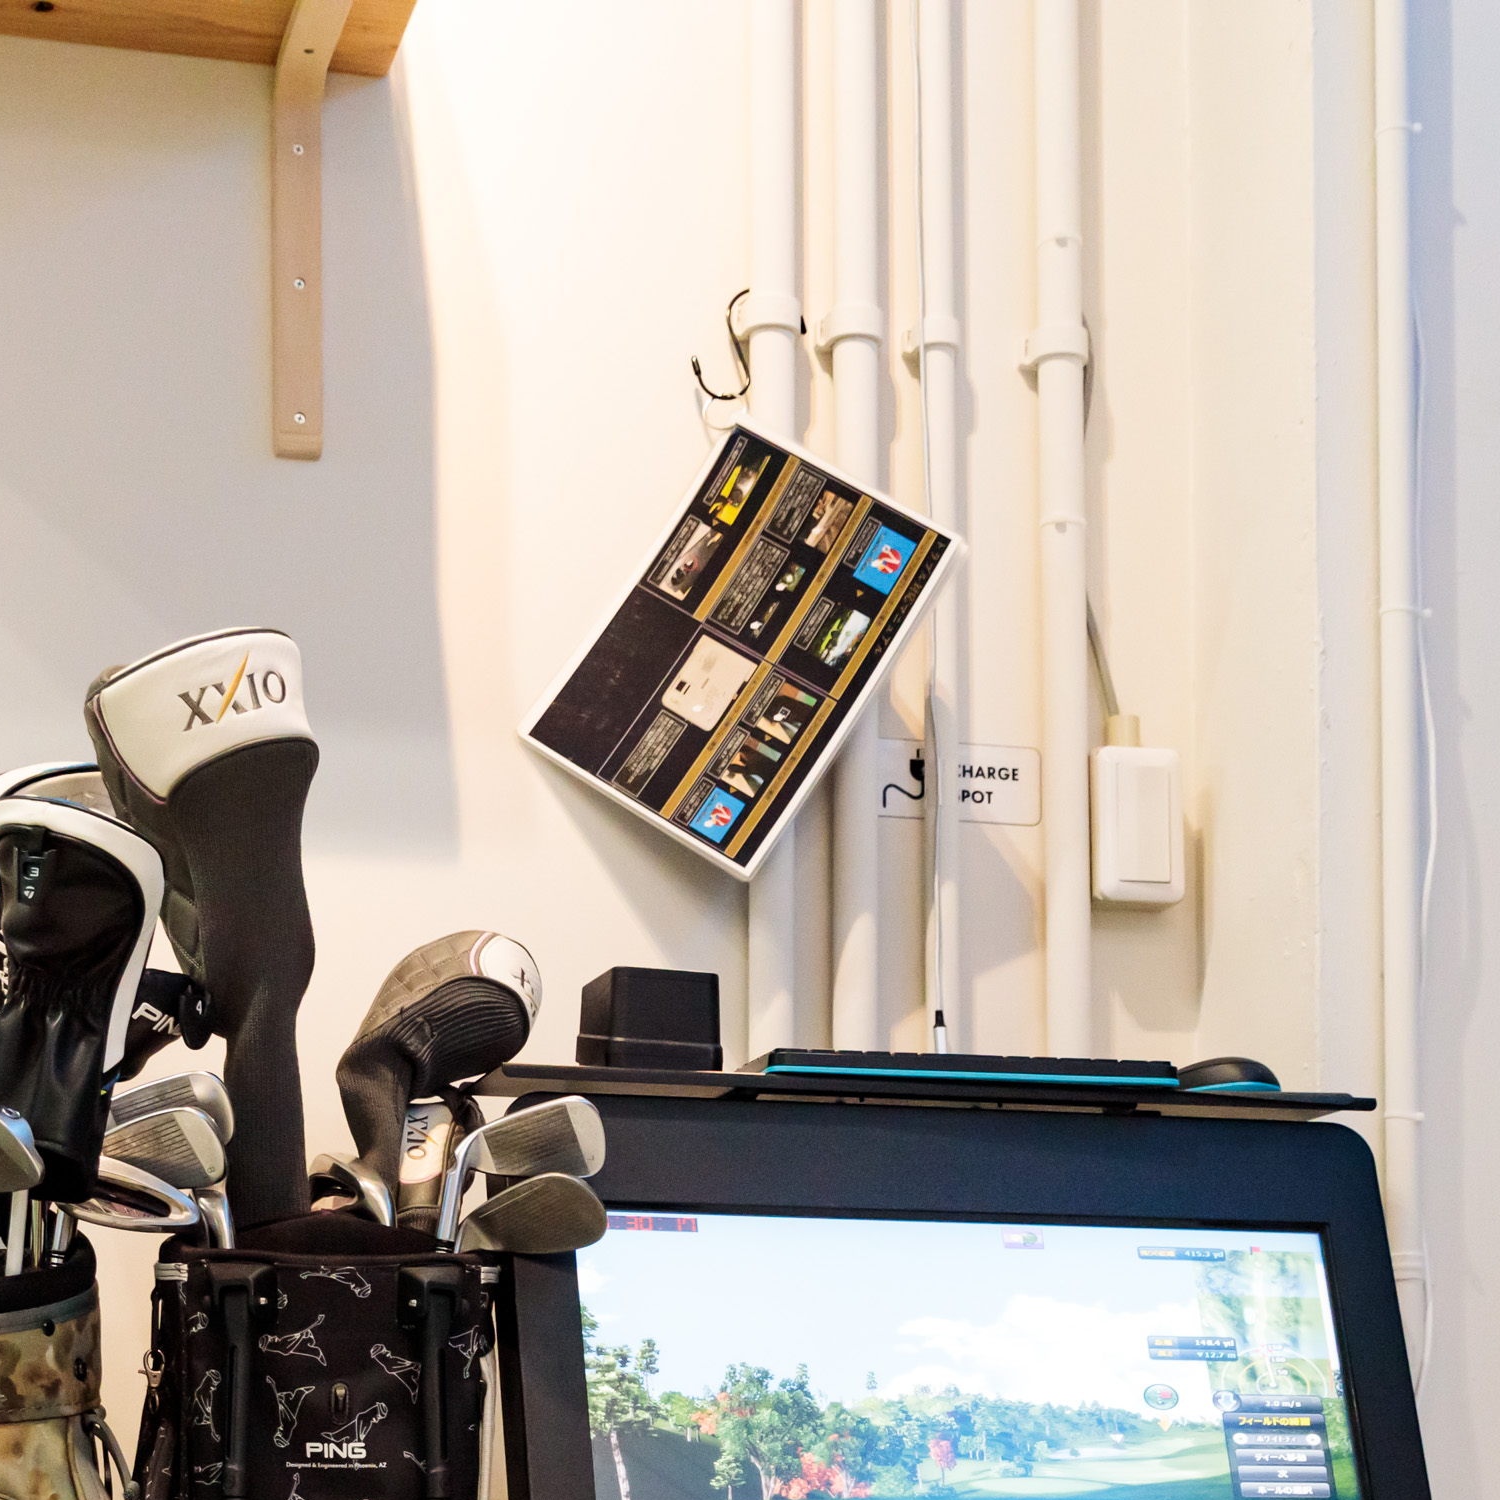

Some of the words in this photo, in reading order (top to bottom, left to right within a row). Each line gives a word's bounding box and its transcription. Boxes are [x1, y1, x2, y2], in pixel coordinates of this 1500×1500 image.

[177, 650, 287, 732] XXIO
[958, 764, 1020, 782] HARGE
[958, 789, 993, 805] POT
[195, 1000, 203, 1015] 4
[406, 1114, 439, 1160] XXIO
[1184, 1250, 1210, 1258] 415.3
[1212, 1250, 1224, 1259] yd
[1222, 1340, 1235, 1349] yd
[305, 1442, 367, 1459] PING
[286, 1461, 311, 1469] Designed
